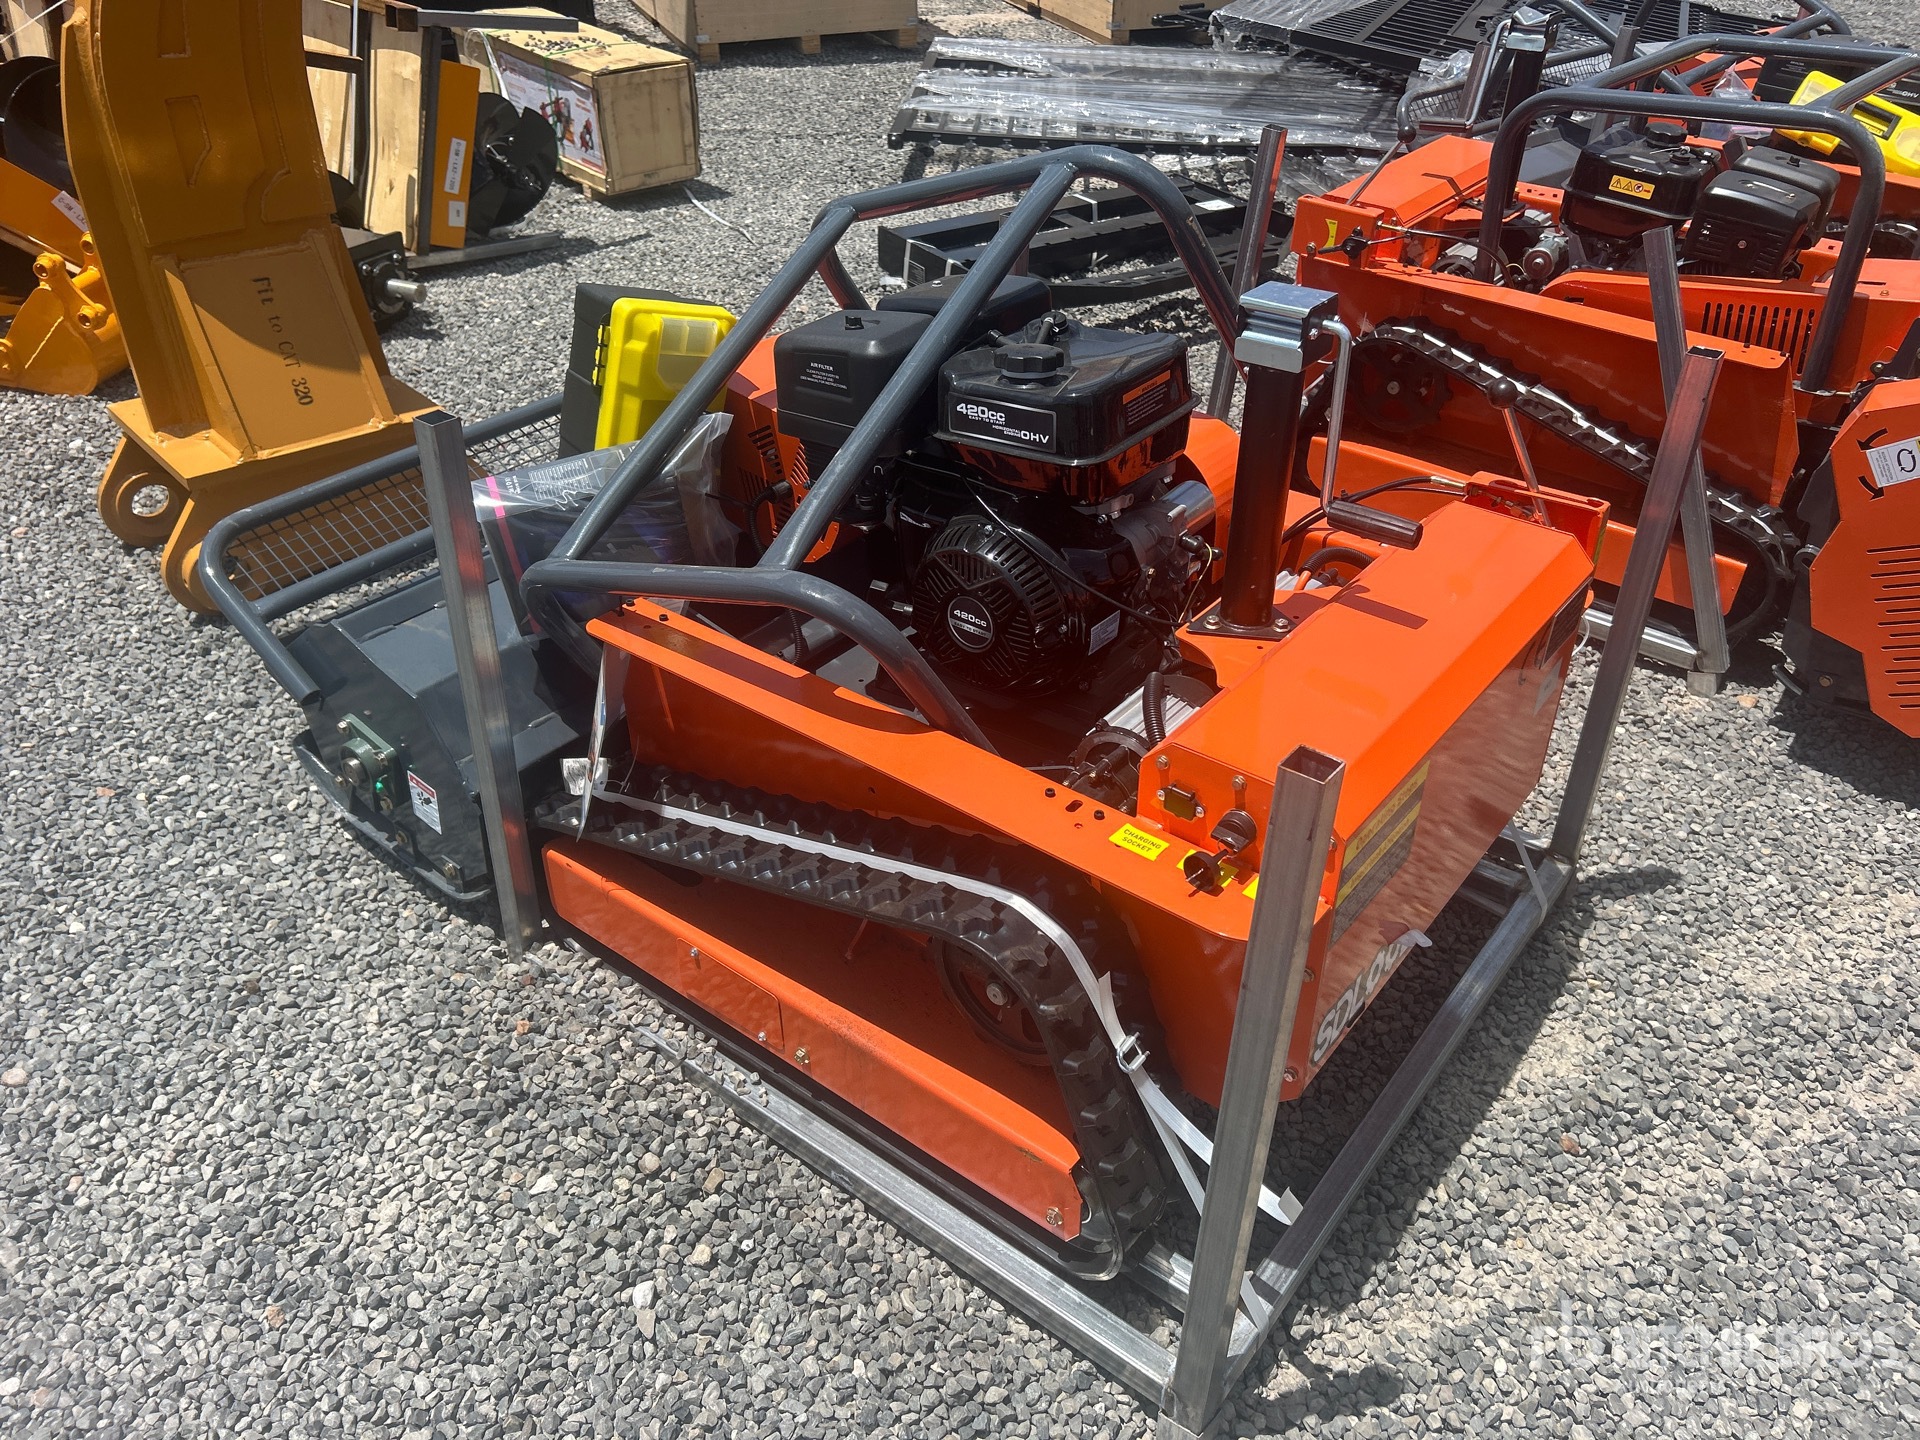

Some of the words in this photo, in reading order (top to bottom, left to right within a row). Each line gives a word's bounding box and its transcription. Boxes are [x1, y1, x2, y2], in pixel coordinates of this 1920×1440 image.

[252, 277, 275, 306] Fit
[268, 315, 283, 334] to
[278, 341, 301, 368] CAT
[291, 377, 314, 406] 320
[818, 363, 834, 371] FILTER
[956, 403, 1006, 422] 420cc
[992, 424, 1021, 434] HORIZONTAL
[1020, 430, 1049, 444] OHV
[953, 609, 987, 627] 420cc
[1121, 836, 1153, 852] SOCKET
[1123, 828, 1162, 849] CHARGING
